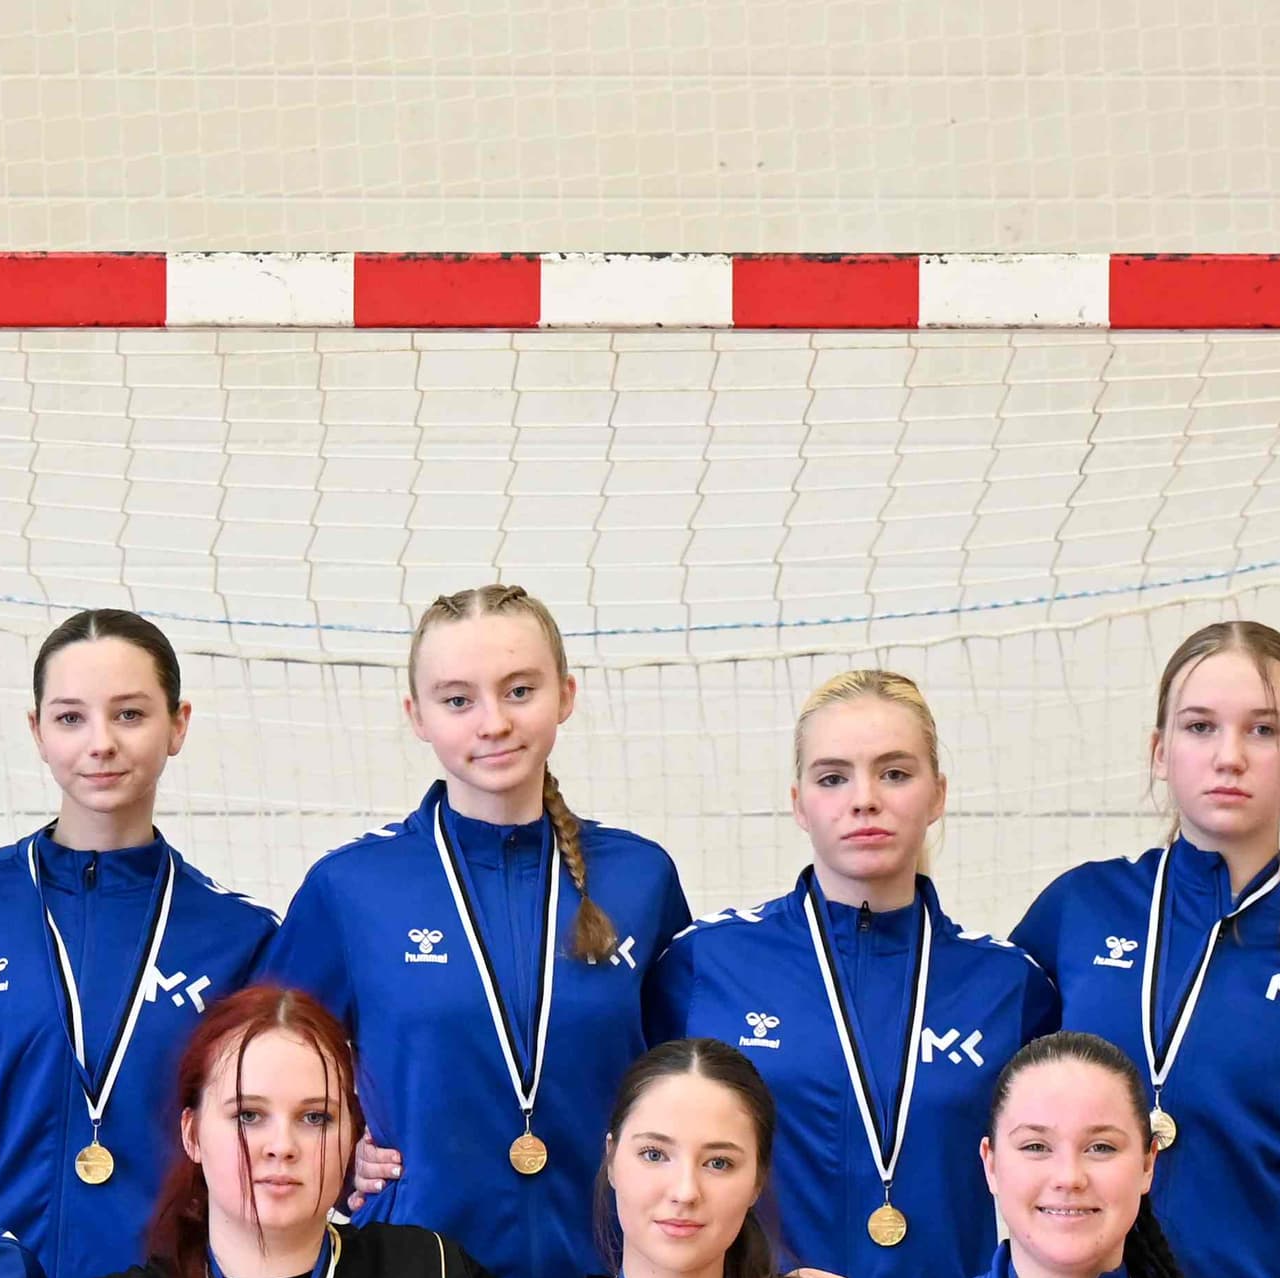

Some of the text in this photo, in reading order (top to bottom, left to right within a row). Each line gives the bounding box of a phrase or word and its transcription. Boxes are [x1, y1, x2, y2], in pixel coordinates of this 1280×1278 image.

[404, 952, 448, 964] hummel
[1093, 956, 1133, 970] hummel
[739, 1036, 781, 1049] hummel
